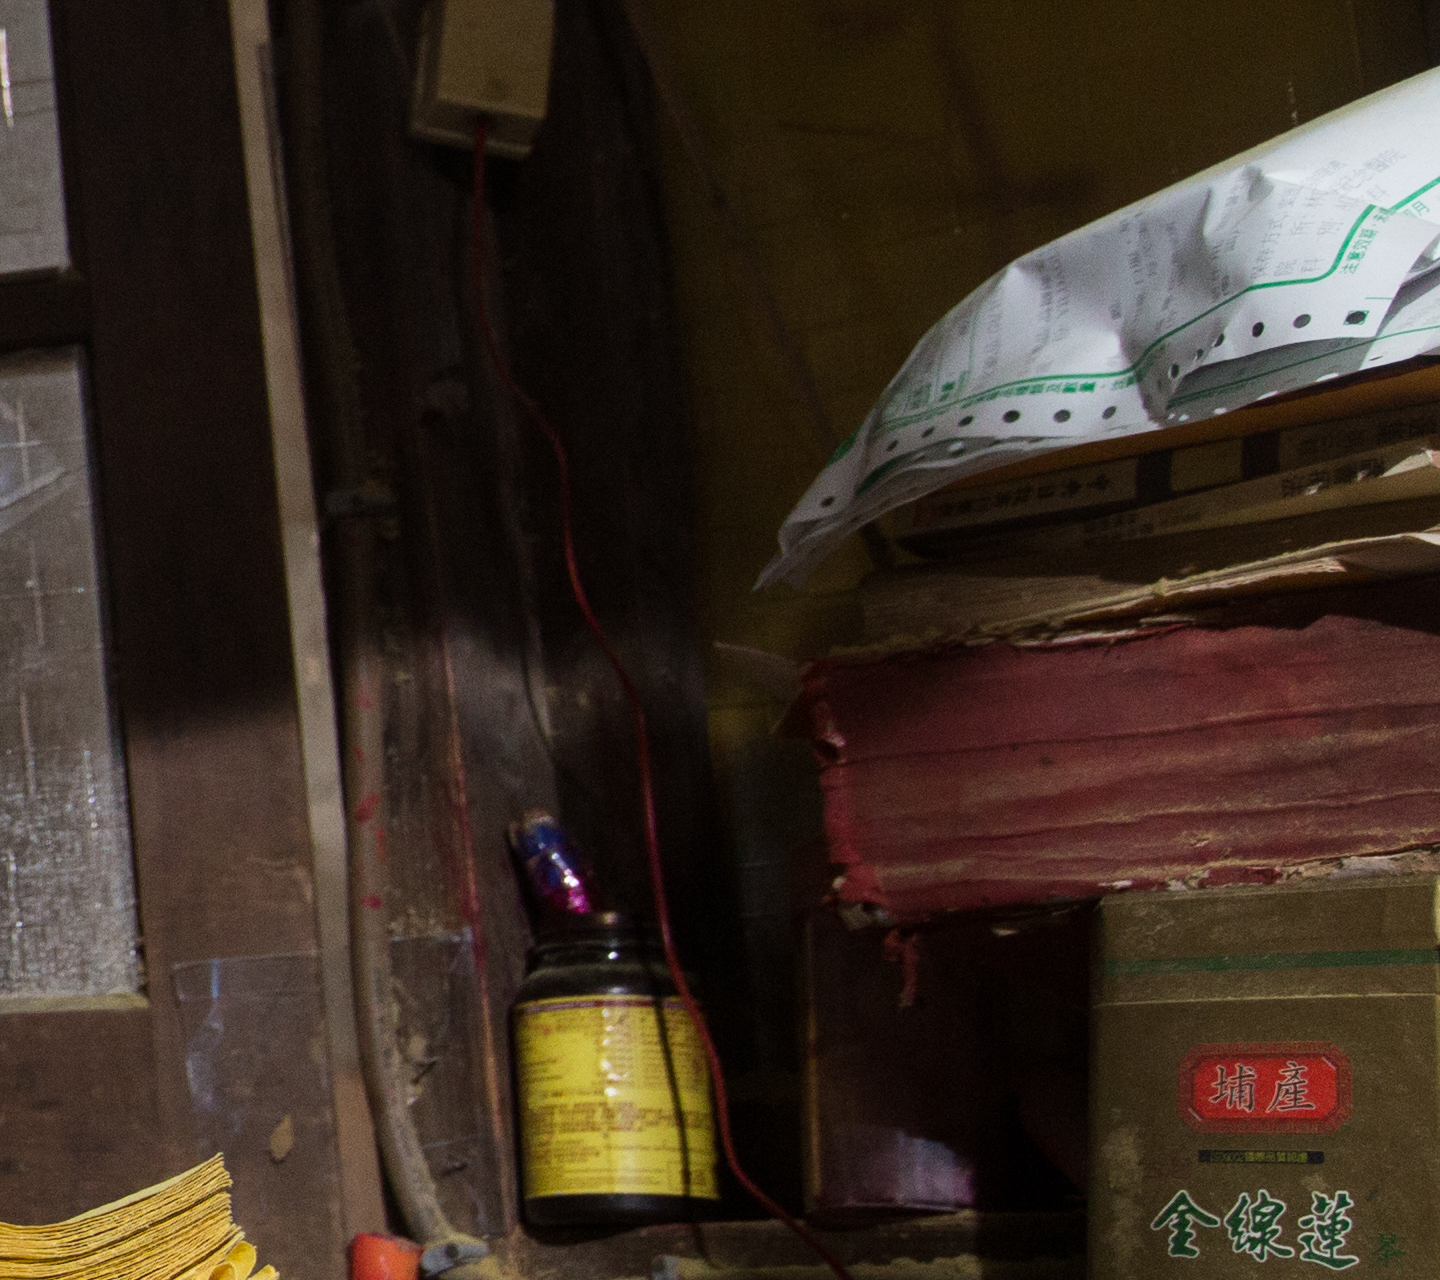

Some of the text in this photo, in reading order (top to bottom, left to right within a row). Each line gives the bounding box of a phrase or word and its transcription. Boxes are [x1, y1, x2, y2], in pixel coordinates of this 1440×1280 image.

[1209, 1060, 1317, 1113] 埔產
[1148, 1188, 1360, 1270] 金線蓮
